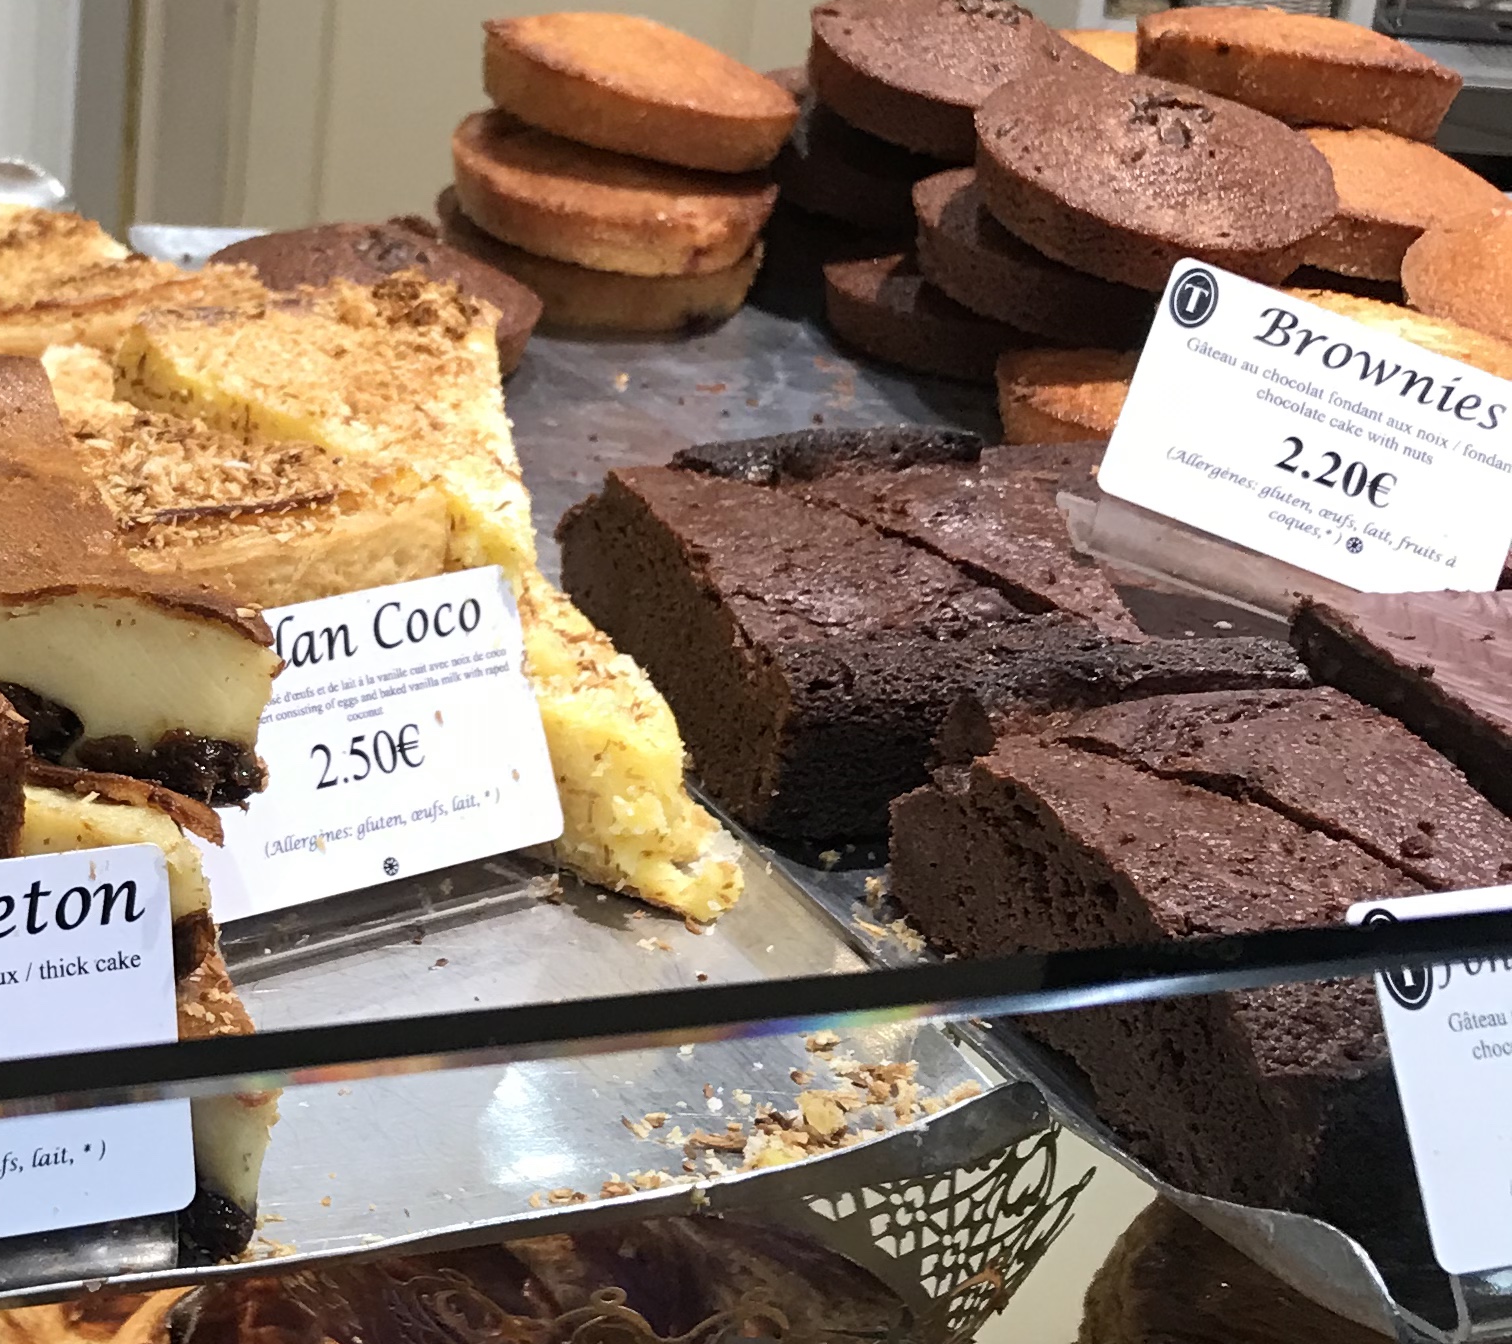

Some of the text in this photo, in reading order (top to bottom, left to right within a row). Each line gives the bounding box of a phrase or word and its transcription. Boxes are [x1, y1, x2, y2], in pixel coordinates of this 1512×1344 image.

[1253, 308, 1507, 431] Brownies
[1187, 337, 1238, 366] Gâteau
[1241, 360, 1259, 375] au
[1262, 368, 1324, 400] chocolat
[1328, 391, 1384, 423] fondant
[1386, 416, 1413, 435] aux
[1416, 428, 1449, 449] noix
[1462, 444, 1512, 474] fondan
[1256, 388, 1434, 465] chocolate cake with nuts
[1274, 435, 1398, 509] 2.20€
[1166, 446, 1258, 491] (Allergènes:
[1258, 485, 1313, 514] gluten,
[1318, 507, 1357, 532] œufs,
[1363, 521, 1393, 546] lait,
[1394, 536, 1441, 563] fruits
[275, 597, 481, 670] lan Coco
[275, 703, 324, 722] consisting
[326, 697, 337, 711] of
[337, 694, 359, 711] eggs
[361, 689, 379, 704] and
[381, 683, 407, 699] baked
[409, 675, 439, 693] vanilla
[441, 670, 462, 686] milk
[463, 665, 484, 681] with
[485, 660, 510, 677] raped
[317, 686, 326, 696] et
[327, 680, 340, 694] de
[341, 677, 358, 692] lait
[358, 675, 365, 687] à
[366, 673, 376, 686] la
[376, 667, 408, 683] vanille
[409, 664, 429, 677] cuit
[429, 660, 450, 673] avec
[451, 654, 471, 668] noix
[473, 651, 485, 663] de
[486, 648, 508, 660] coco
[347, 705, 384, 723] coconut
[310, 723, 425, 789] 2.50€
[356, 813, 408, 841] gluten,
[410, 800, 449, 824] œufs,
[452, 794, 481, 814] lait,
[24, 962, 33, 983] /
[38, 955, 90, 983] thick
[95, 949, 141, 975] cake
[1448, 1011, 1509, 1033] Gâteau
[1472, 1039, 1512, 1060] choc
[31, 1145, 75, 1171] lait,
